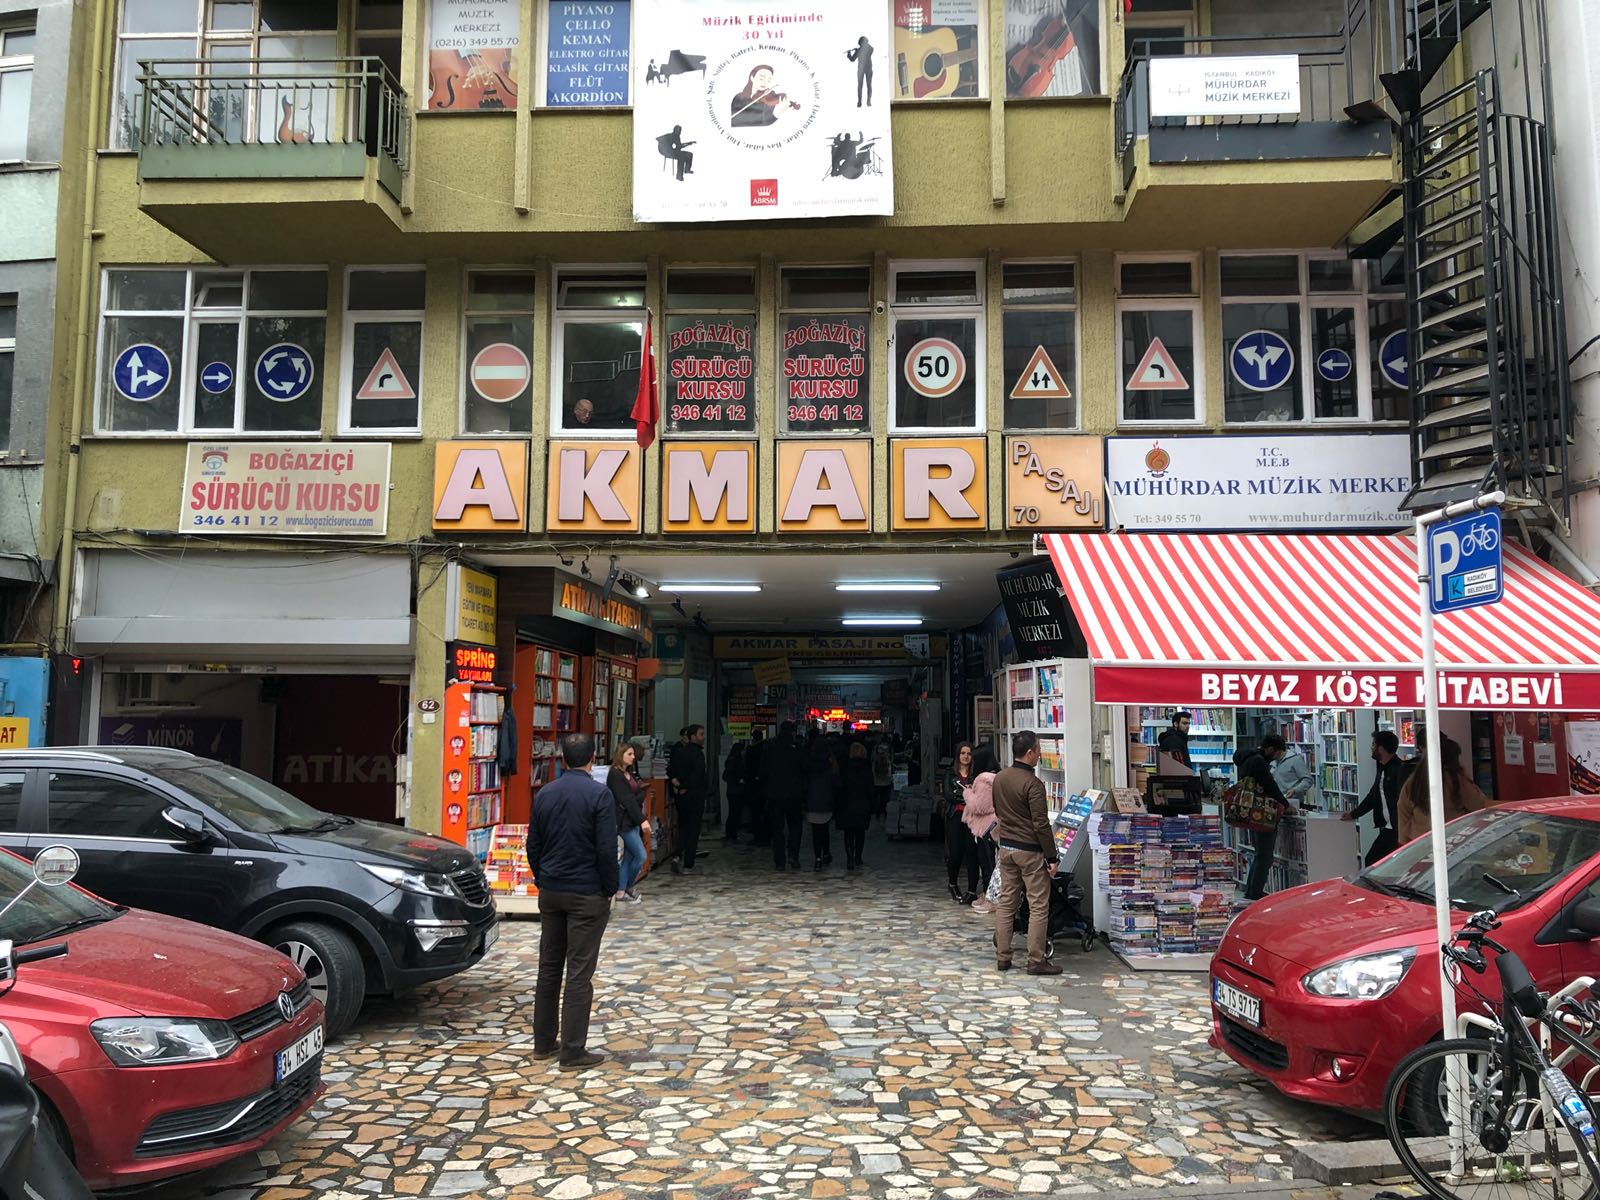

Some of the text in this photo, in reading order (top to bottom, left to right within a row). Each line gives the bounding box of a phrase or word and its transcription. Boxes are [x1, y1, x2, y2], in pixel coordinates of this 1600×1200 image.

[563, 4, 614, 16] PİYANO
[565, 20, 611, 32] ÇELLO
[702, 13, 824, 26] Müzik Eğitiminde
[897, 15, 928, 23] ABM
[453, 23, 502, 33] MERKEZİ
[742, 29, 784, 40] 30 Yıl
[435, 37, 519, 48] (0216) 349 55 70
[563, 35, 612, 45] KEMAN
[549, 48, 629, 59] ELEKTRO GİTAR
[549, 62, 629, 73] KLASİK GİTAR
[569, 75, 605, 88] FLÜT
[1205, 78, 1267, 89] MÜHÜRDAR
[551, 90, 624, 103] AKORDİON
[1205, 90, 1291, 102] MÜZİK MERKEZİ
[668, 319, 751, 352] BOĞAZİÇİ
[783, 318, 866, 352] BOĞAZİÇİ
[671, 355, 752, 378] SÜRÜCÜ
[783, 353, 865, 377] SÜRÜCÜ
[917, 355, 950, 379] 50
[677, 380, 746, 400] KURSU
[789, 379, 858, 399] KURSU
[670, 404, 746, 421] 346 41 12
[787, 404, 863, 421] 346 41 12
[1260, 447, 1283, 457] T.C.
[249, 448, 354, 476] BOĞAZİÇİ
[1256, 458, 1290, 467] M.E.B
[435, 446, 979, 523] AKMAR
[1012, 440, 1100, 524] PASAJI
[1113, 475, 1410, 496] MÜHÜRDAR MÜZİK MERKE
[190, 476, 381, 513] SÜRÜCÜ KURSU
[193, 514, 374, 529] 346 41 12 www.bogazicisurucu.com
[1014, 506, 1040, 523] 70
[1134, 512, 1413, 524] Tel: 349 55 70 www.muhurdarmuzik.com
[1433, 530, 1460, 602] P
[1001, 572, 1055, 597] MÜHÜRDAR
[1466, 572, 1488, 583] KADIKÖY
[1467, 583, 1494, 595] BELEDİYESİ
[1016, 596, 1050, 618] MÜZİK
[1019, 620, 1063, 642] MERKEZİ
[730, 638, 798, 649] AKMAR
[808, 638, 873, 649] PASAJI
[456, 648, 496, 669] SPRİNG
[1201, 673, 1300, 701] BEYAZ
[1315, 670, 1398, 707] KÖŞE
[421, 700, 435, 710] 62
[147, 723, 195, 747] MİNÖR
[283, 747, 395, 784] ATİKA
[1218, 983, 1226, 1003] 34
[1228, 988, 1237, 1008] TS
[1238, 994, 1259, 1019] 9717
[282, 1028, 322, 1075] 34 HSZ 45
